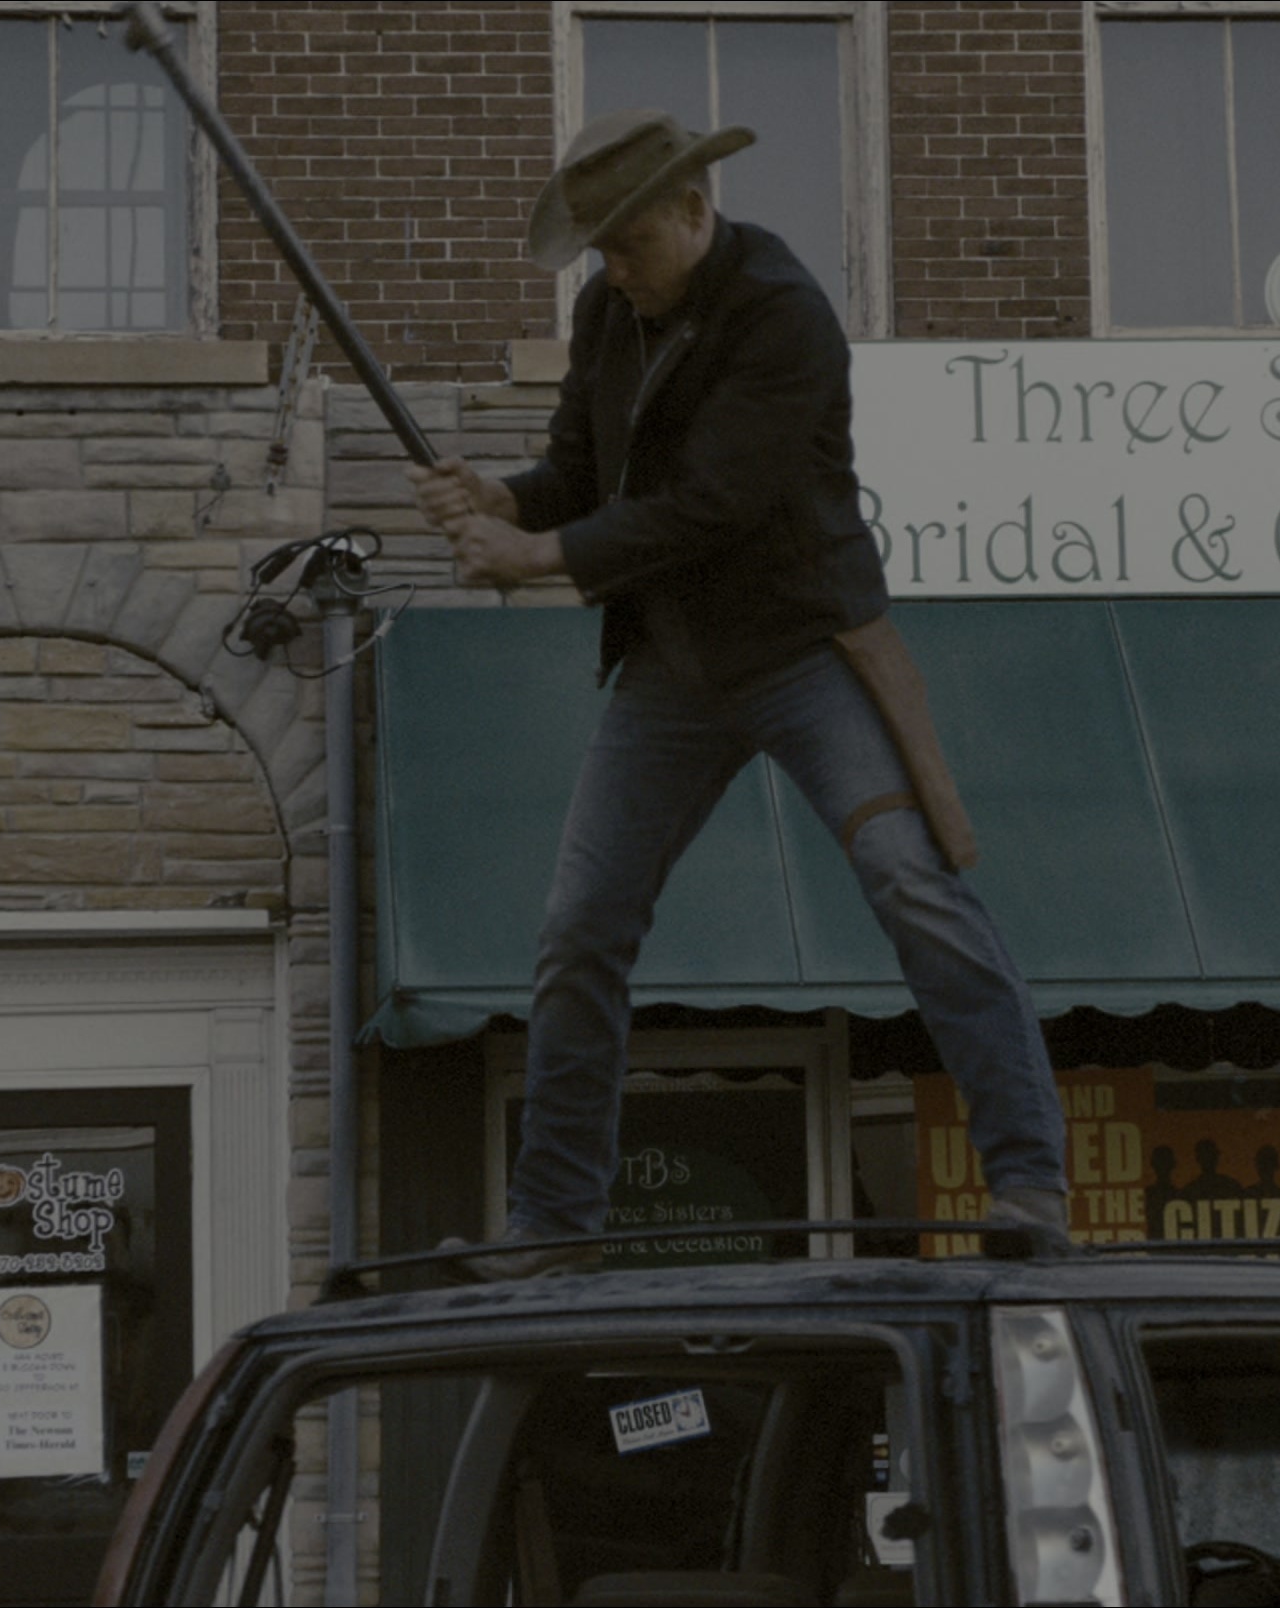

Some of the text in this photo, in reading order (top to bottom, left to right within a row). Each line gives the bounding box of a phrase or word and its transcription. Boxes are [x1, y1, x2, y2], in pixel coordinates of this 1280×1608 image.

[945, 349, 1231, 454] Three
[1171, 492, 1242, 583] &
[623, 1148, 690, 1190] TBS
[34, 1198, 113, 1252] Shop
[654, 1201, 734, 1221] Sisters
[1084, 1189, 1146, 1224] THE
[616, 1402, 673, 1435] CLOSED
